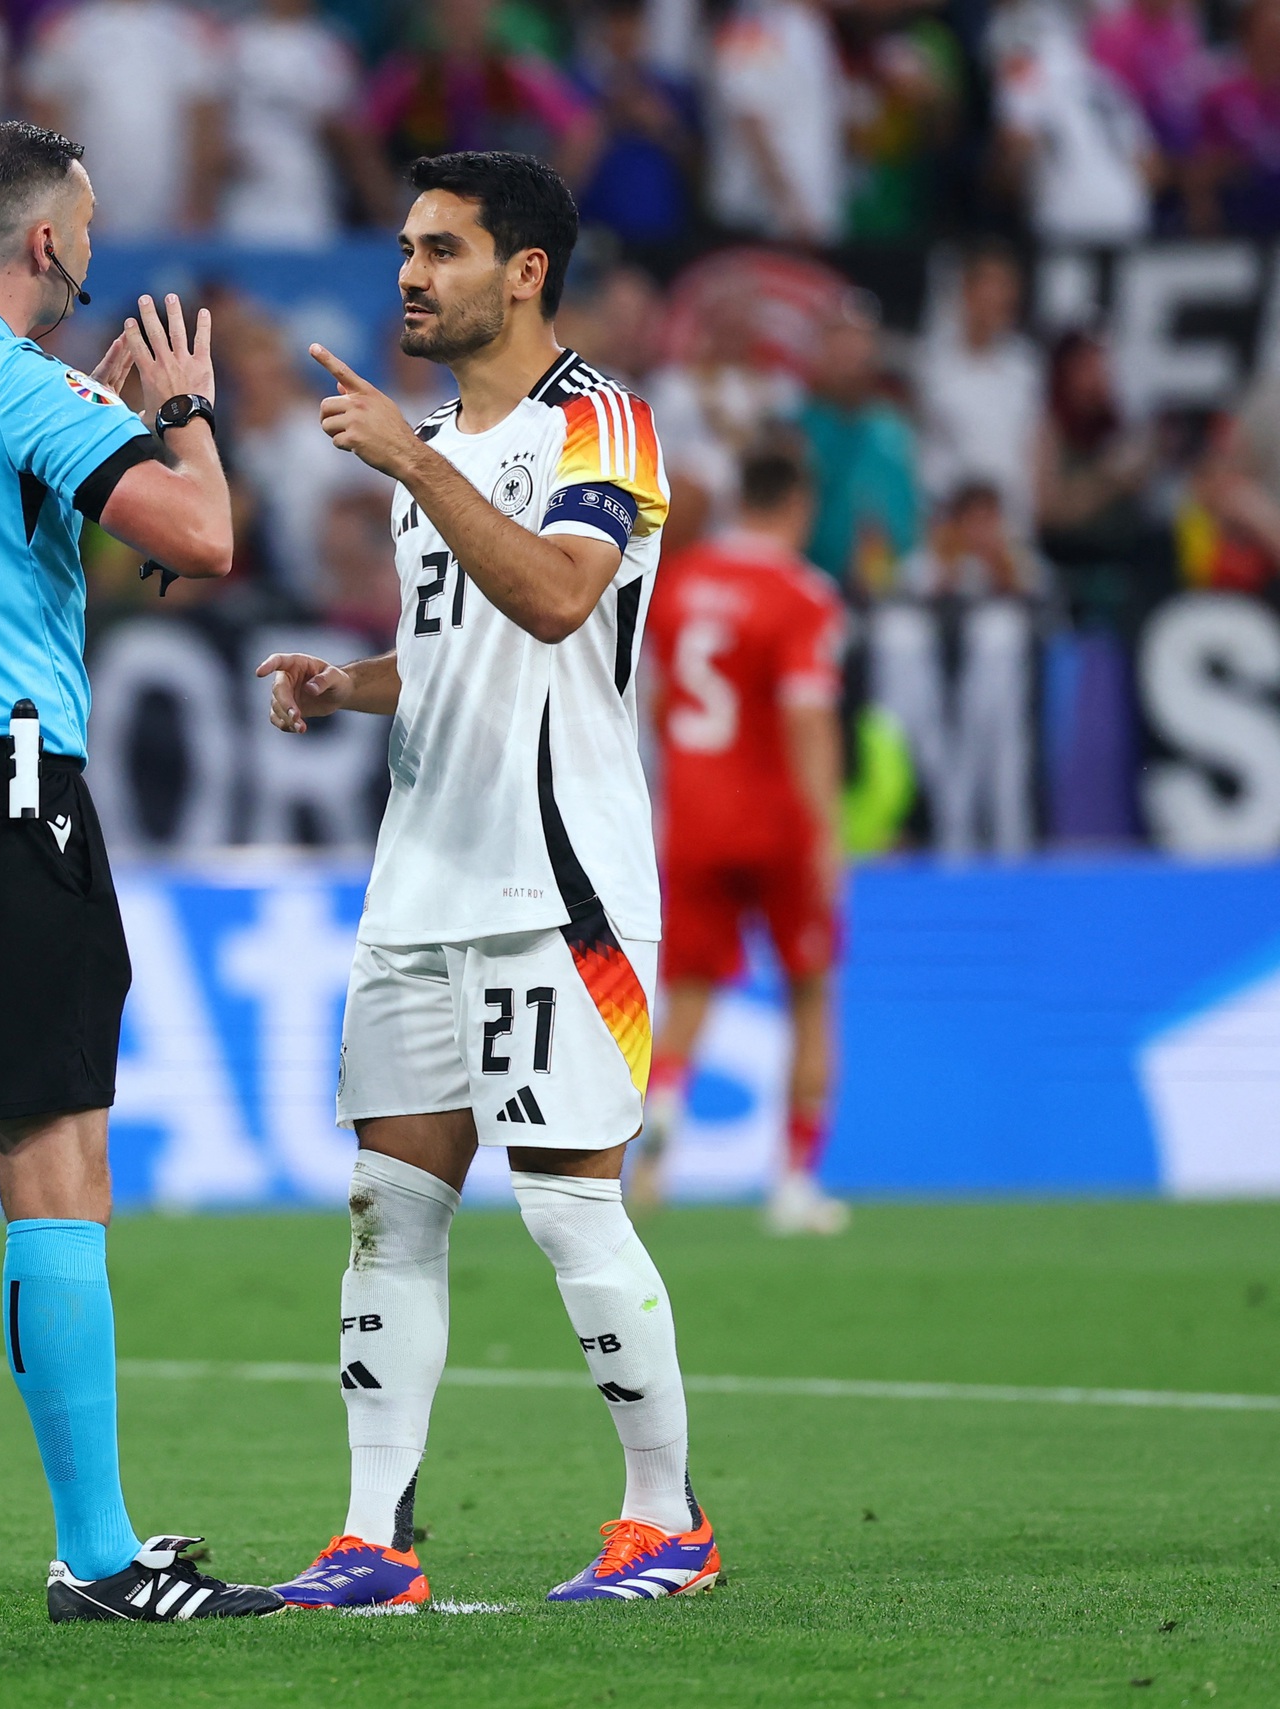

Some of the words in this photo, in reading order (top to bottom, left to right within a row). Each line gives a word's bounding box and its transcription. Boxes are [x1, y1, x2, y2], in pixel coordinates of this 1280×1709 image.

[414, 551, 469, 638] 21
[668, 612, 741, 756] 5
[482, 986, 557, 1075] 21
[340, 1314, 383, 1335] FB
[577, 1333, 622, 1354] FB
